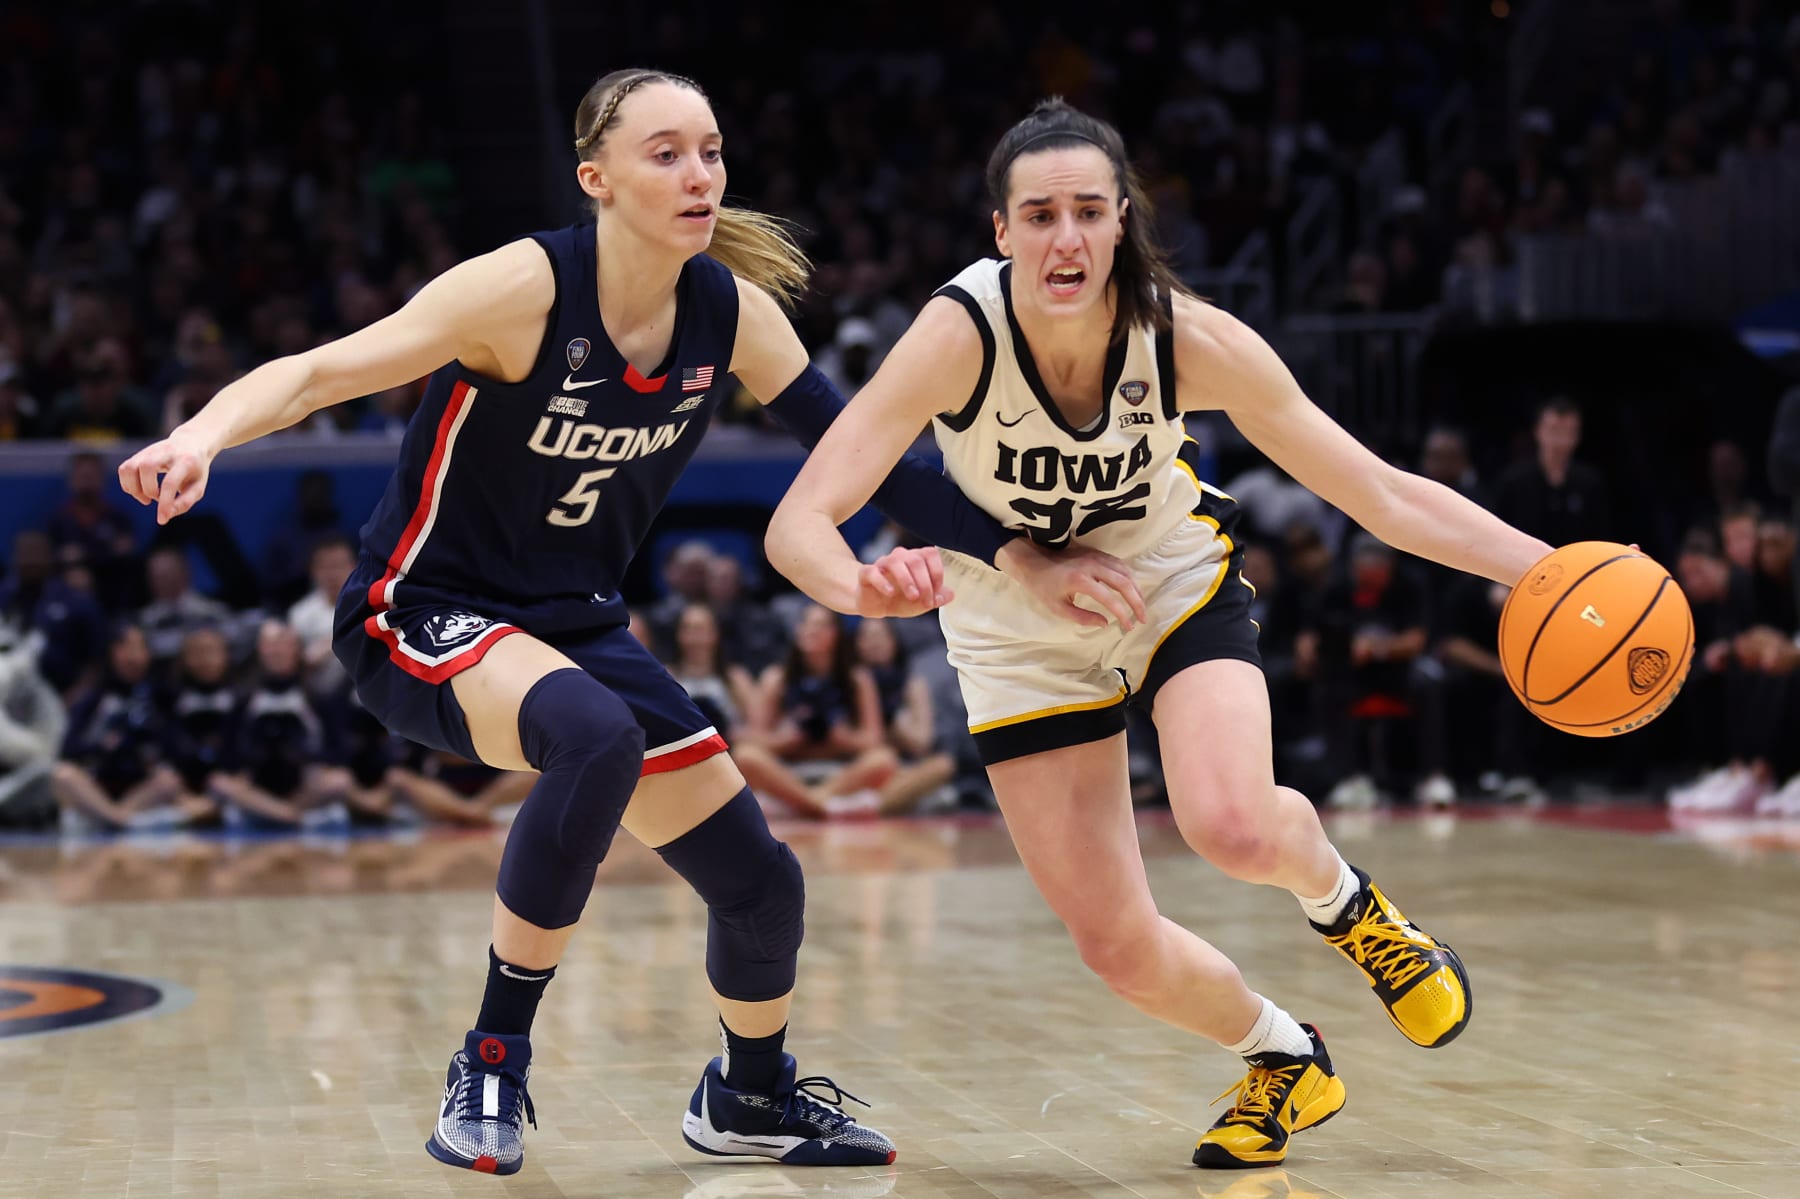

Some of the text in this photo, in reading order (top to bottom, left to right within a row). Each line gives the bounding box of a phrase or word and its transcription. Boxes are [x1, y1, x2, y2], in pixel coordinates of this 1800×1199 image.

[547, 405, 587, 418] CHANGE
[527, 416, 690, 461] UCONN
[994, 433, 1152, 493] IOWA
[546, 467, 618, 527] 5
